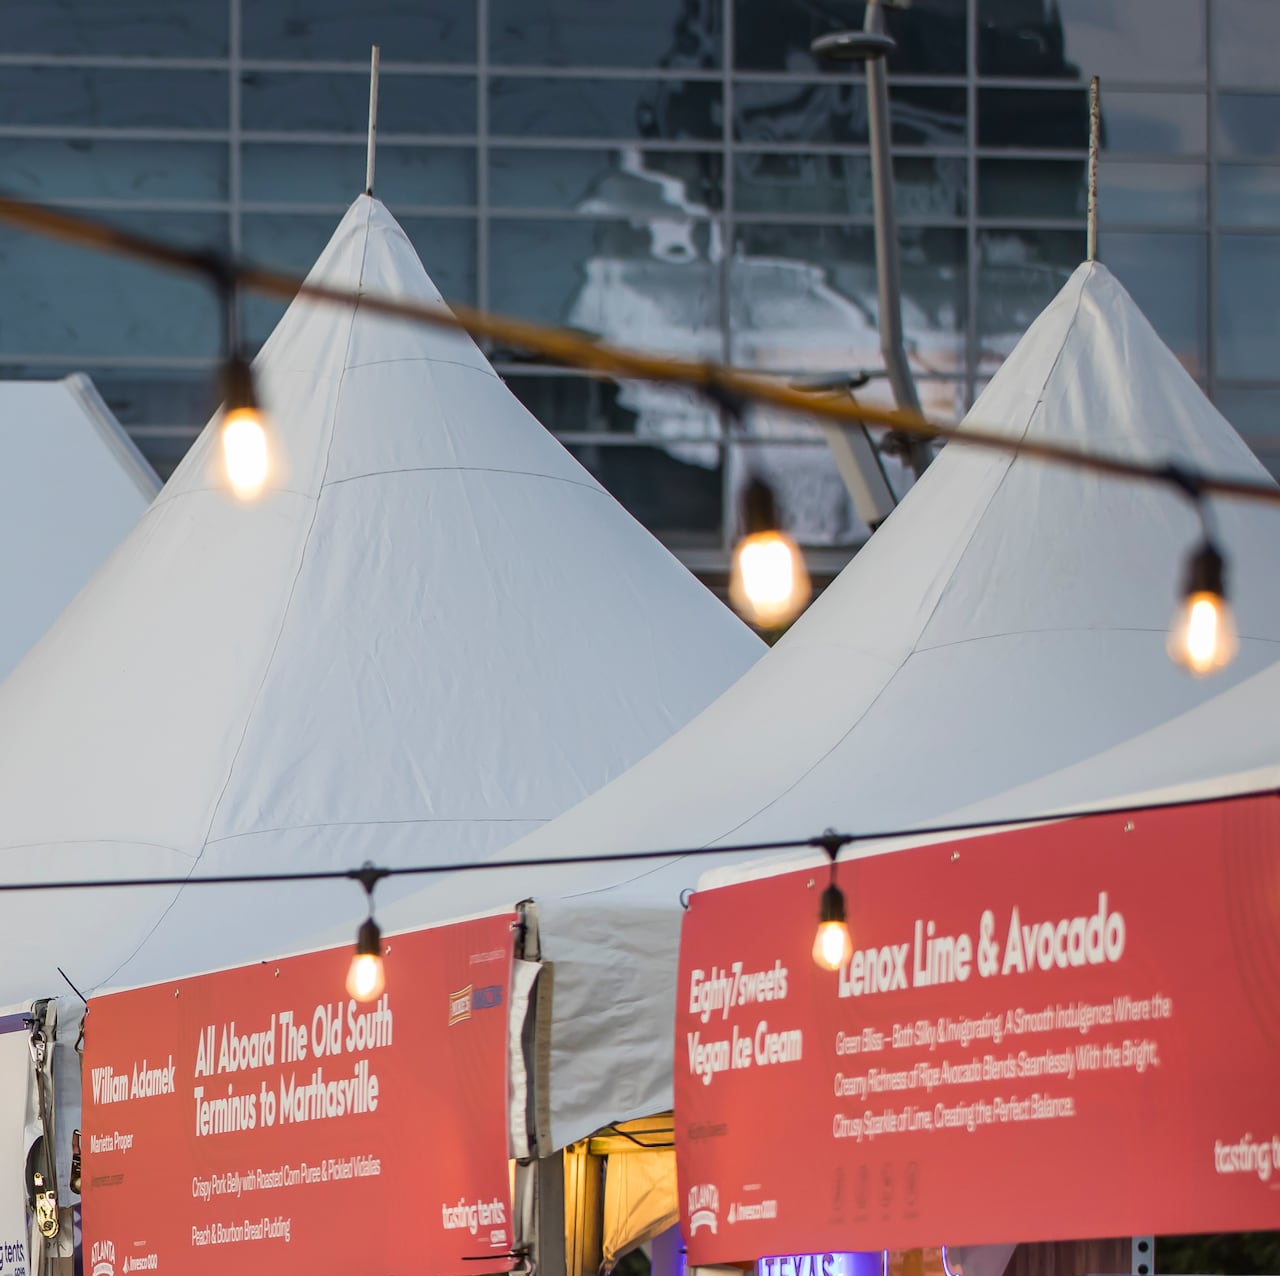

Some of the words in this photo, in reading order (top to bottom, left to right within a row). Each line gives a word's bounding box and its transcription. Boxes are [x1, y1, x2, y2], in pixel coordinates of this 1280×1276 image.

[838, 941, 909, 998] Lenox
[913, 919, 972, 987] Lime
[977, 910, 999, 978] &
[1002, 891, 1126, 976] Avocado
[194, 1025, 215, 1078] All
[217, 1013, 275, 1074] Aboard
[279, 1011, 308, 1063] The
[311, 1002, 343, 1058] Old
[345, 993, 393, 1052] South
[835, 1031, 860, 1056] Green
[862, 1027, 884, 1052] Bliss
[892, 1023, 913, 1048] Both
[914, 1020, 937, 1051] Silky
[1014, 1005, 1054, 1034] Smooth
[1055, 1001, 1113, 1034] Indulgence
[1113, 995, 1150, 1022] Where
[1151, 993, 1172, 1019] the
[687, 1031, 730, 1086] Vegan
[731, 1025, 752, 1069] Ice
[754, 1020, 802, 1066] Cream
[868, 1067, 908, 1092] Richness
[941, 1057, 982, 1084] Avocado
[982, 1053, 1017, 1080] Blends
[1017, 1047, 1075, 1079] Seamlessly
[1076, 1043, 1100, 1070] With
[1102, 1043, 1121, 1068] the
[91, 1064, 129, 1104] William
[130, 1055, 176, 1099] Adamek
[194, 1083, 256, 1137] Terminus
[260, 1081, 275, 1127] to
[280, 1059, 379, 1124] Marthasville
[934, 1101, 976, 1132] Creating
[976, 1099, 992, 1124] the
[992, 1096, 1030, 1122] Perfect
[90, 1134, 113, 1153] Marietta
[114, 1131, 133, 1154] Proper
[1214, 1132, 1271, 1181] tasting
[192, 1176, 211, 1202] Crispy
[212, 1174, 226, 1195] Pork
[227, 1171, 241, 1198] Belly
[241, 1169, 256, 1191] with
[257, 1166, 283, 1190] Roasted
[284, 1165, 300, 1186] Corn
[192, 1225, 210, 1246] Peach
[211, 1223, 216, 1244] &
[217, 1221, 243, 1244] Bourbon
[244, 1218, 262, 1241] Bread
[264, 1216, 290, 1242] Pudding
[442, 1197, 477, 1235] tasting
[478, 1197, 506, 1225] tents
[5, 1240, 25, 1263] tents
[91, 1240, 116, 1267] ATLANTA
